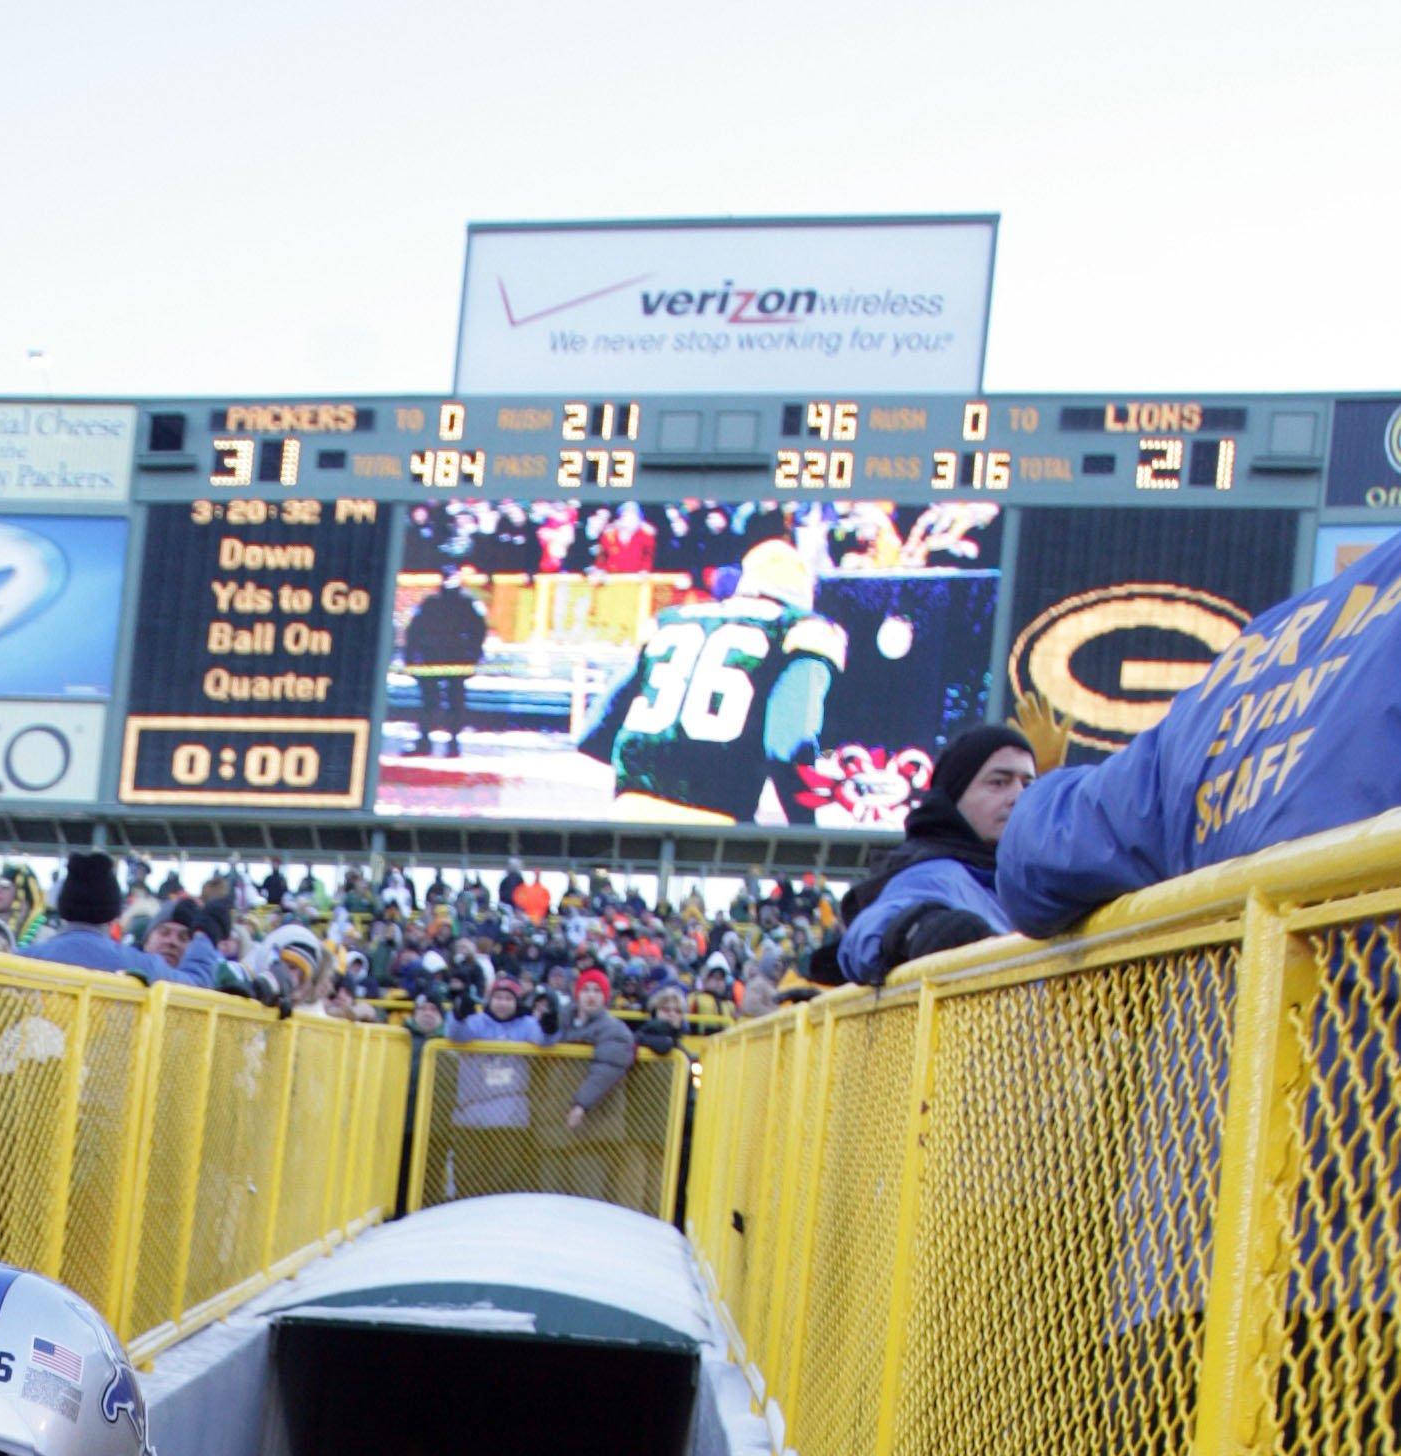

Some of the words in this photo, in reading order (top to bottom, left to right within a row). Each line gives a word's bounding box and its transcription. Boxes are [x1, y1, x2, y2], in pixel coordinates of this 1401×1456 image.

[640, 279, 817, 324] verizon
[819, 288, 944, 318] wireless
[550, 330, 588, 355] We
[593, 332, 665, 353] never
[672, 330, 730, 355] stop
[738, 328, 842, 357] working
[848, 326, 886, 353] for
[36, 408, 126, 437] Cheese
[225, 404, 357, 432] PACKERS
[395, 408, 425, 432] TO
[438, 402, 466, 442] 0
[497, 407, 554, 431] RUSH
[562, 402, 640, 442] 211
[869, 407, 928, 432] RUSH
[962, 402, 989, 442] 0
[1009, 406, 1040, 433] TO
[1104, 402, 1203, 433] LIONS
[0, 440, 27, 459] the
[209, 437, 301, 487] 31
[353, 454, 402, 478] TOTAL
[410, 449, 485, 488] 484
[494, 454, 547, 478] PASS
[557, 449, 635, 488] 273
[1136, 438, 1236, 491] 21
[15, 461, 115, 489] Packers
[774, 450, 854, 489] 220
[865, 455, 922, 480] PASS
[931, 451, 1011, 490] 316
[1019, 456, 1073, 481] TOTAL
[334, 498, 377, 525] PM
[219, 536, 316, 571] Down
[211, 579, 273, 614] Yds
[279, 584, 313, 614] to
[321, 579, 371, 615] Go
[208, 620, 276, 655] Ball
[283, 621, 333, 655] On
[203, 667, 333, 702] Quarter
[623, 622, 770, 743] 36
[171, 743, 321, 787] 0:00
[1194, 727, 1316, 844] STAFF
